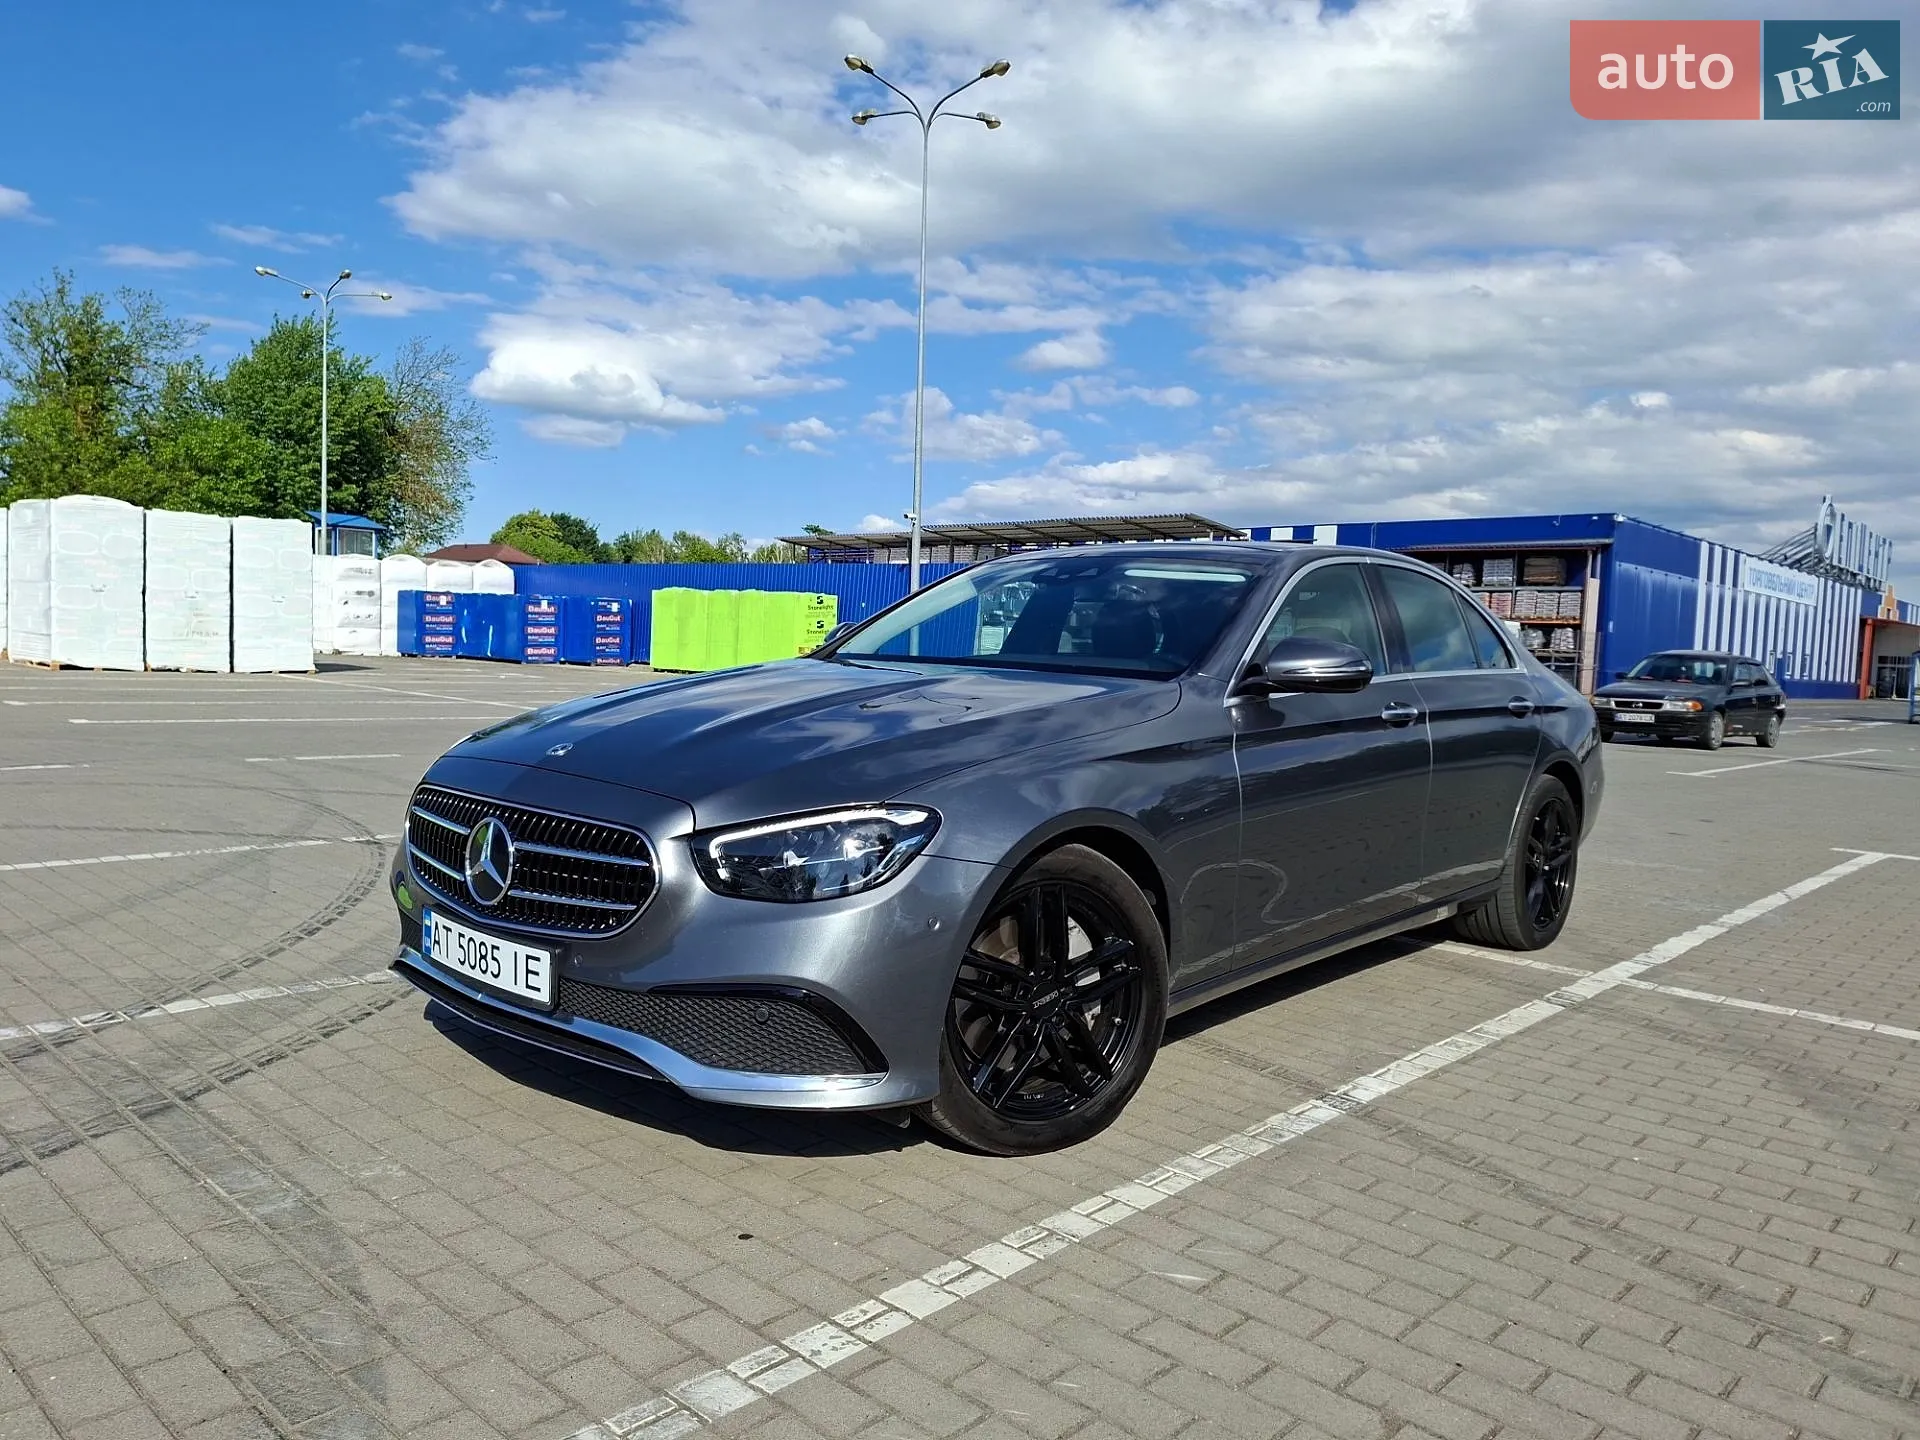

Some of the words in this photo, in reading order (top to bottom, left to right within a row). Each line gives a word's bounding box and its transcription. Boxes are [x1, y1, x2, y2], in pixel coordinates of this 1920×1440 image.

[425, 615, 453, 624] BauGut
[596, 614, 621, 622] BauGut
[527, 626, 556, 635] BauGut
[425, 635, 453, 643] BauGut
[595, 636, 620, 644] BauGut
[527, 647, 556, 655] BauGut
[432, 920, 453, 960] AT
[457, 931, 501, 979] 5085
[514, 950, 541, 993] IE
